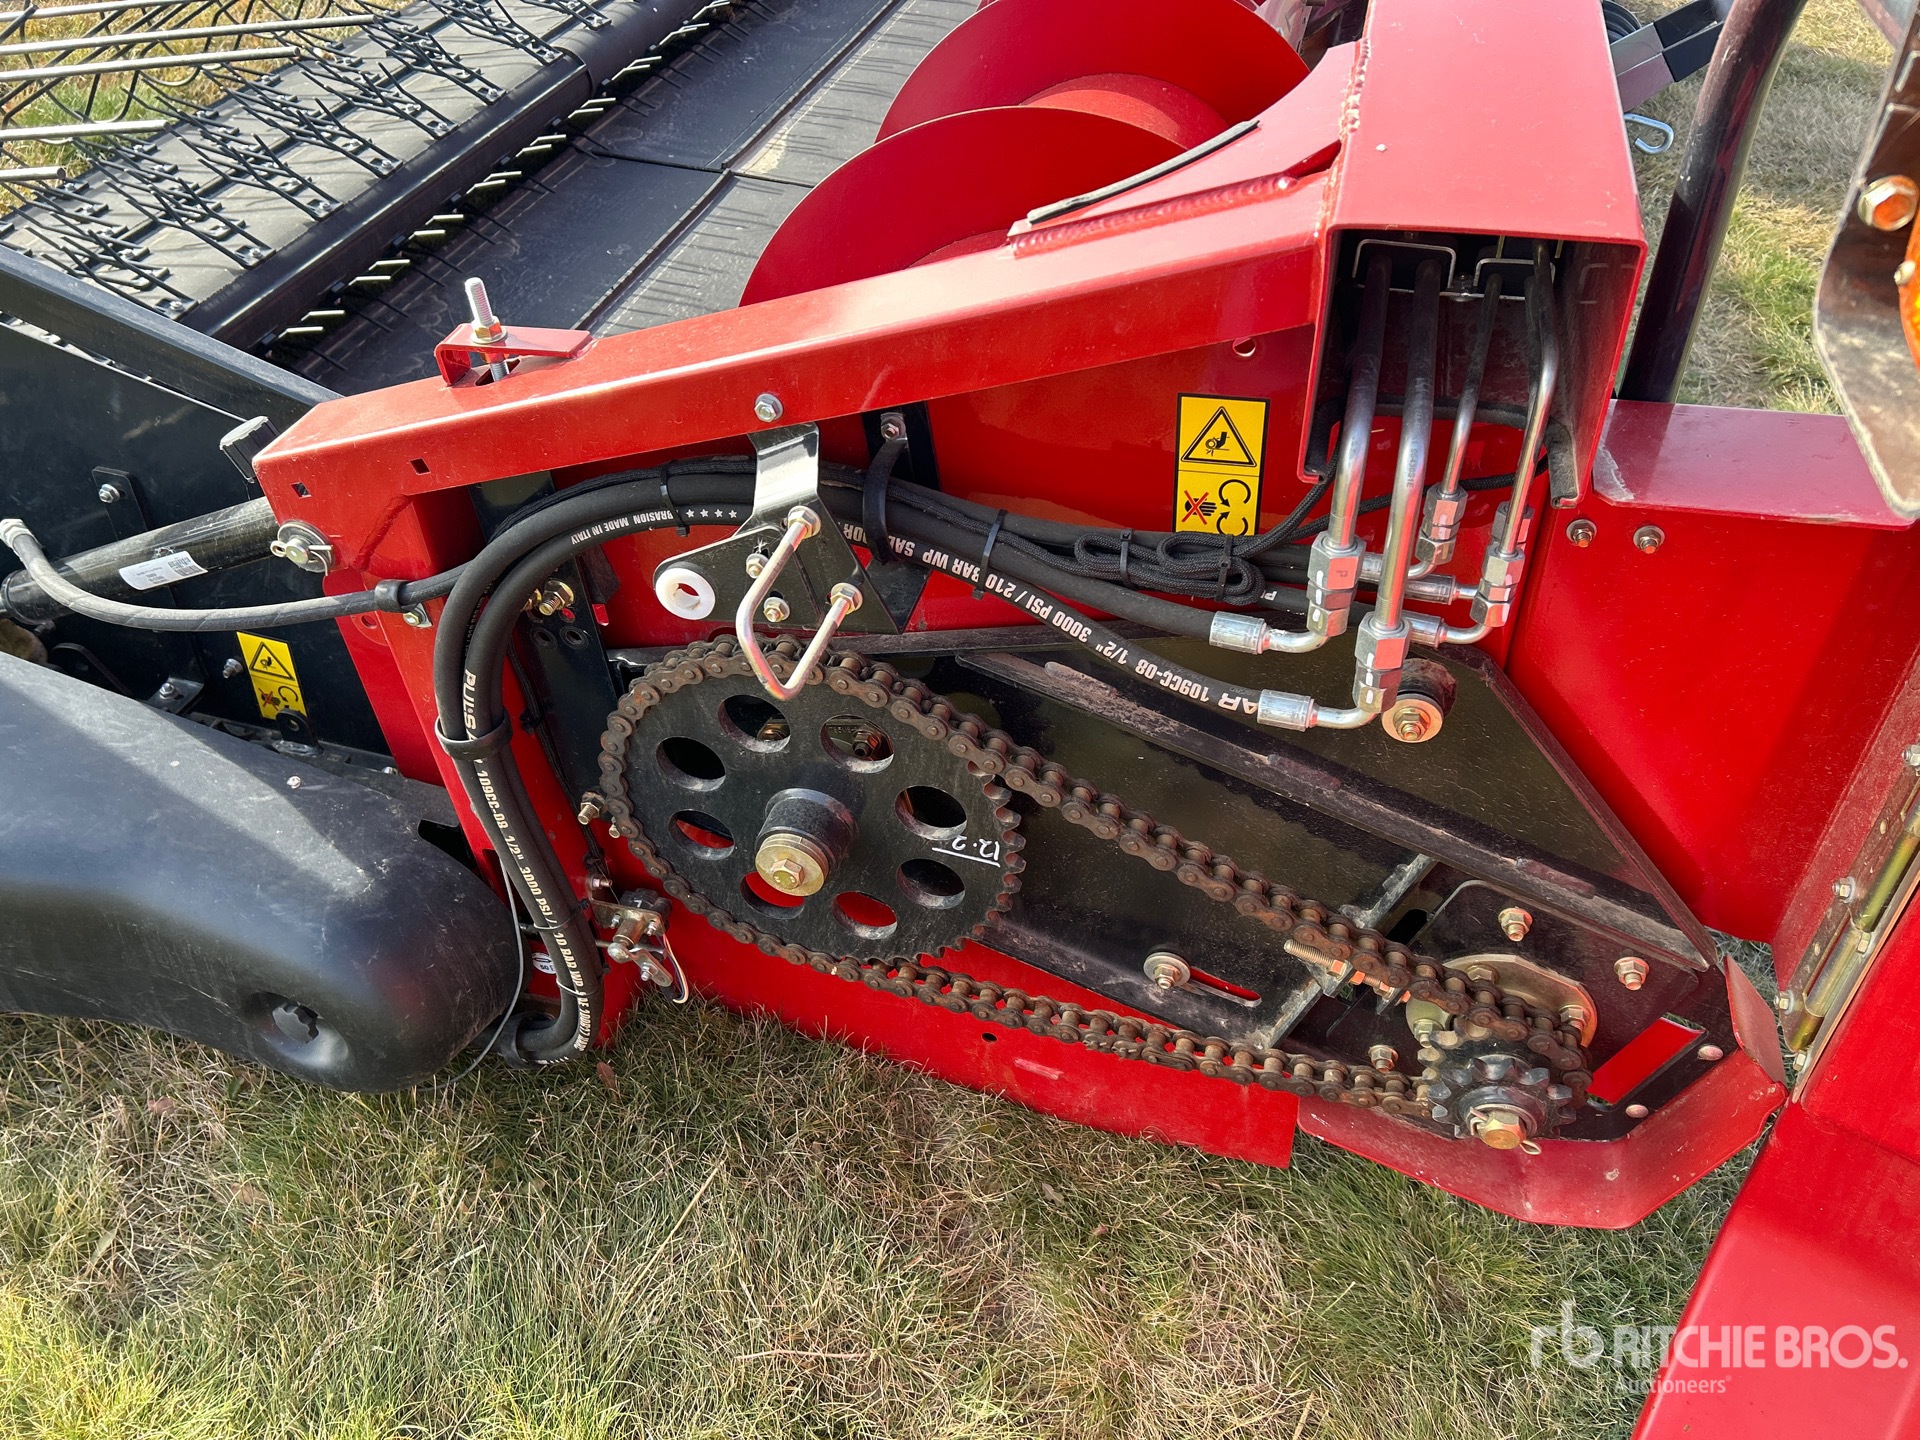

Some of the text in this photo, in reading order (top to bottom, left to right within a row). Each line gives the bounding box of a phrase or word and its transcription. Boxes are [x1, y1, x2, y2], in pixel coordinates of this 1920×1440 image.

[570, 510, 679, 545] BRASION MADE IN ITALY
[922, 548, 950, 570] WP
[985, 573, 1017, 598] 210
[1025, 594, 1053, 620] PSI
[1052, 610, 1092, 643] 3000
[1095, 641, 1129, 665] 1/2"
[1135, 659, 1210, 703] 109CC-08
[477, 769, 509, 829] 109CC-08
[504, 835, 525, 860] 1/2"
[520, 867, 542, 896] 3000
[535, 896, 554, 919] PSI
[553, 931, 568, 947] 10
[559, 947, 579, 970] BAR
[569, 968, 584, 987] WP
